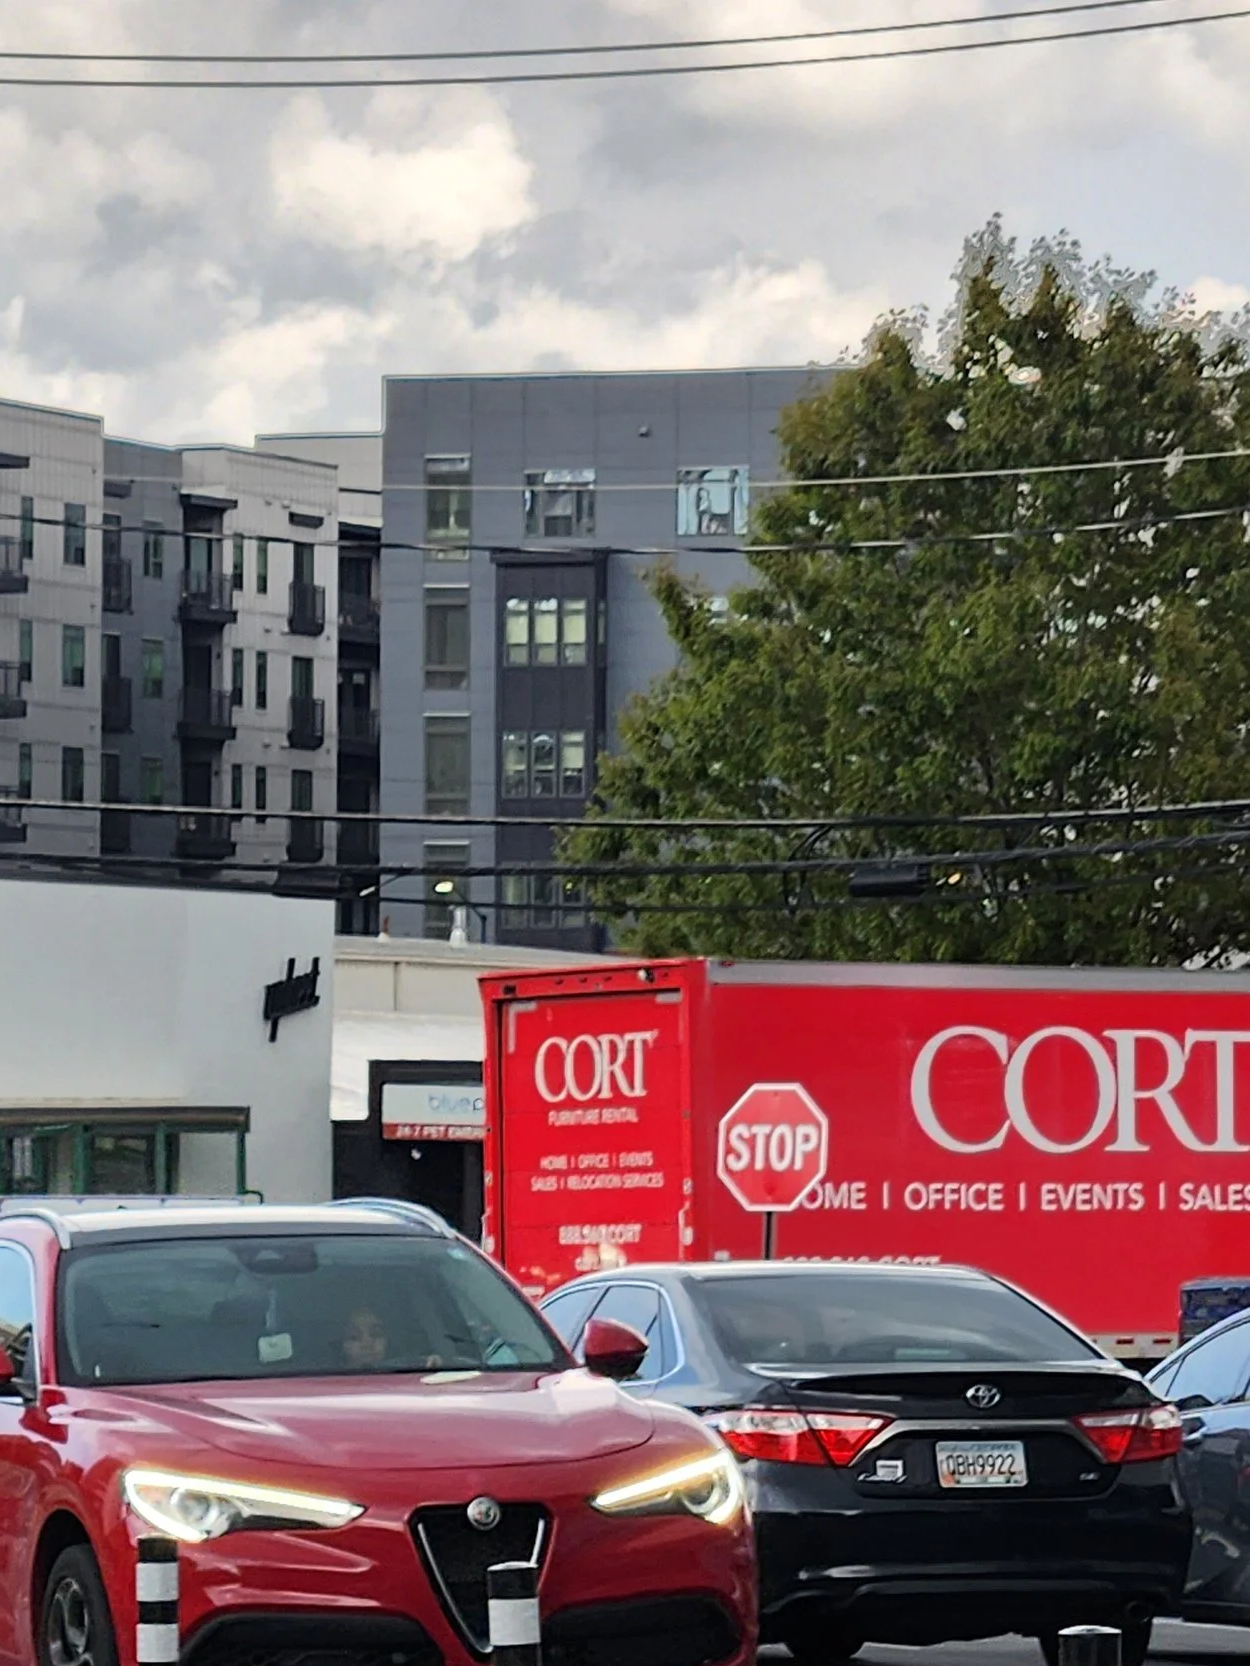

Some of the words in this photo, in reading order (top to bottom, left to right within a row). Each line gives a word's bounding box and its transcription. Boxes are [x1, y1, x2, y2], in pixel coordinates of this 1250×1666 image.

[535, 1032, 655, 1103] CORT
[910, 1025, 1250, 1154] CORT
[548, 1108, 600, 1126] FURNITURE
[601, 1106, 639, 1124] RENTAL
[540, 1155, 568, 1170] HOME
[578, 1153, 610, 1169] OFFICE
[619, 1151, 654, 1167] EVENTS
[726, 1123, 819, 1172] STOP
[531, 1175, 558, 1191] SALES
[567, 1174, 621, 1190] RELOCATION
[622, 1171, 665, 1188] SERVICES
[802, 1181, 867, 1211] OME
[904, 1182, 1004, 1211] OFFICE
[1040, 1182, 1145, 1211] EVENTS
